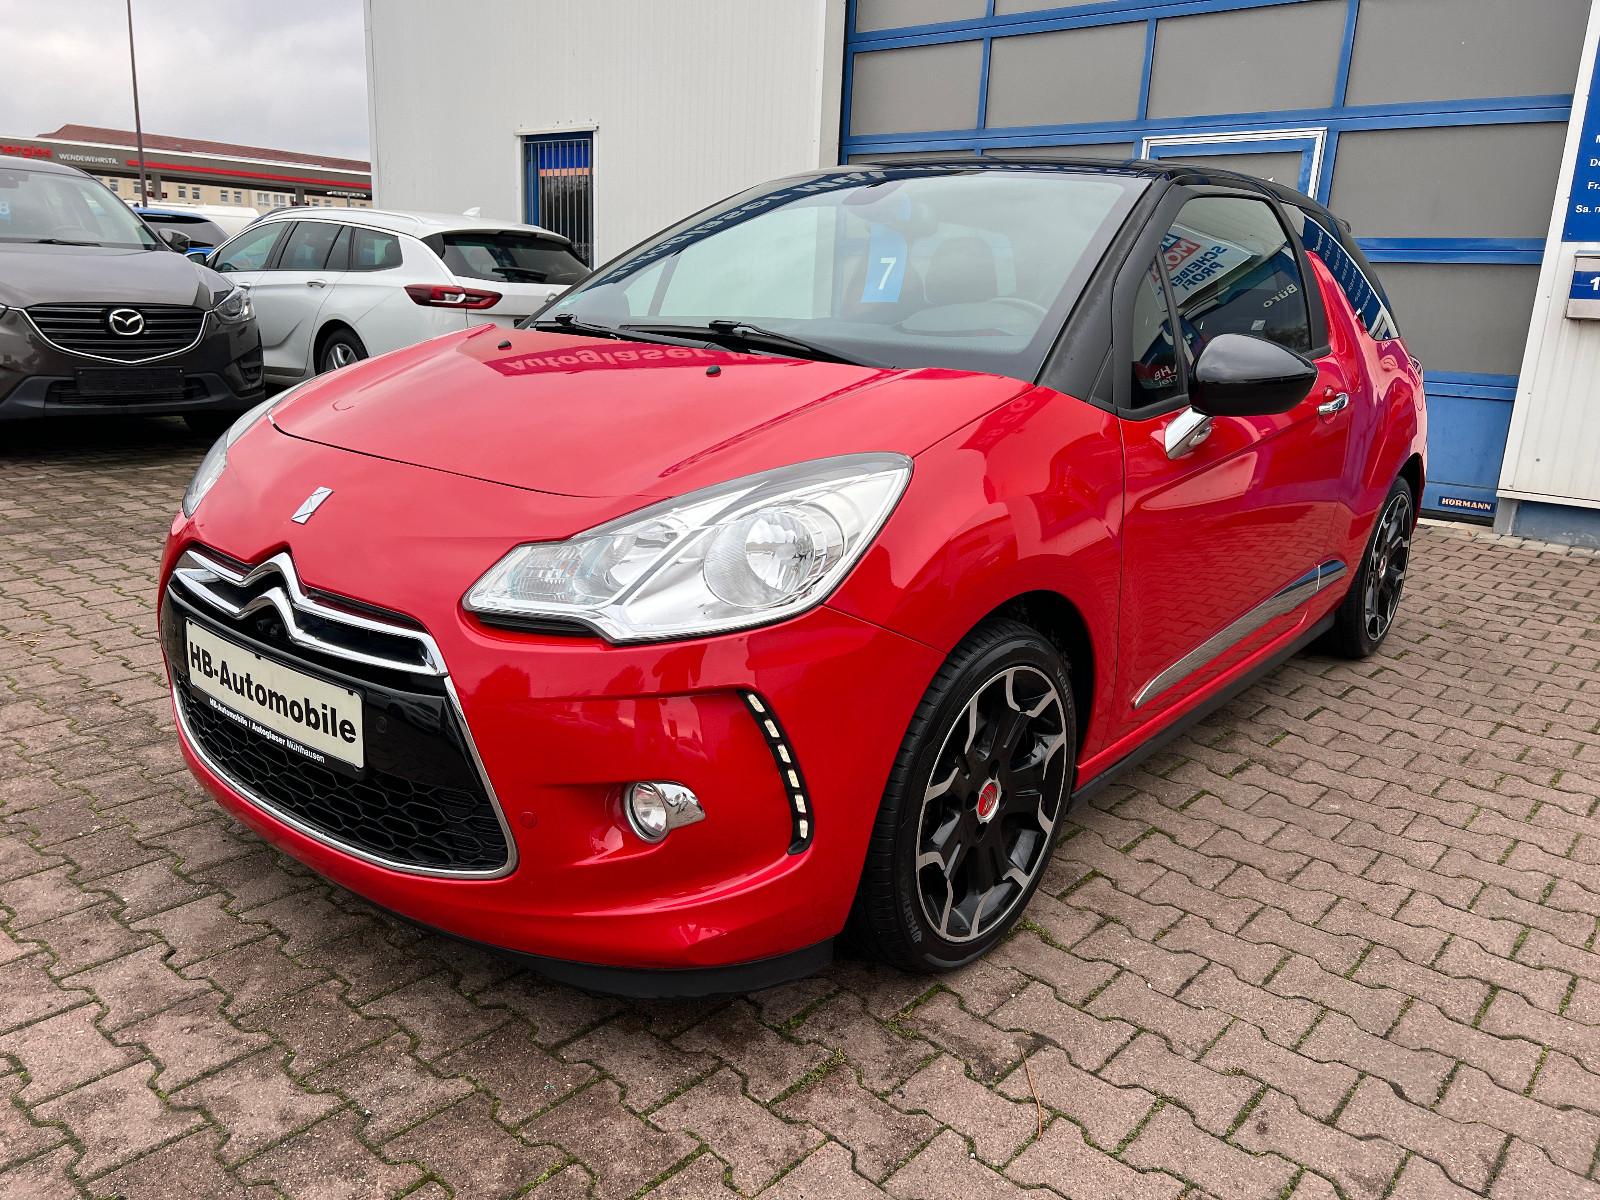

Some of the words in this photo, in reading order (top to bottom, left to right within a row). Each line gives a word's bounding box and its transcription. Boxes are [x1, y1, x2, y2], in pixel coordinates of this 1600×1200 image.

[59, 153, 119, 165] WENDEWEHRSTR.
[1575, 204, 1592, 213] Sa.
[878, 256, 897, 291] 7
[189, 641, 357, 744] HB-Automobile
[209, 697, 248, 727] HB-Automobile
[251, 722, 286, 746] Autoglaser
[286, 738, 325, 764] Mühlhausen
